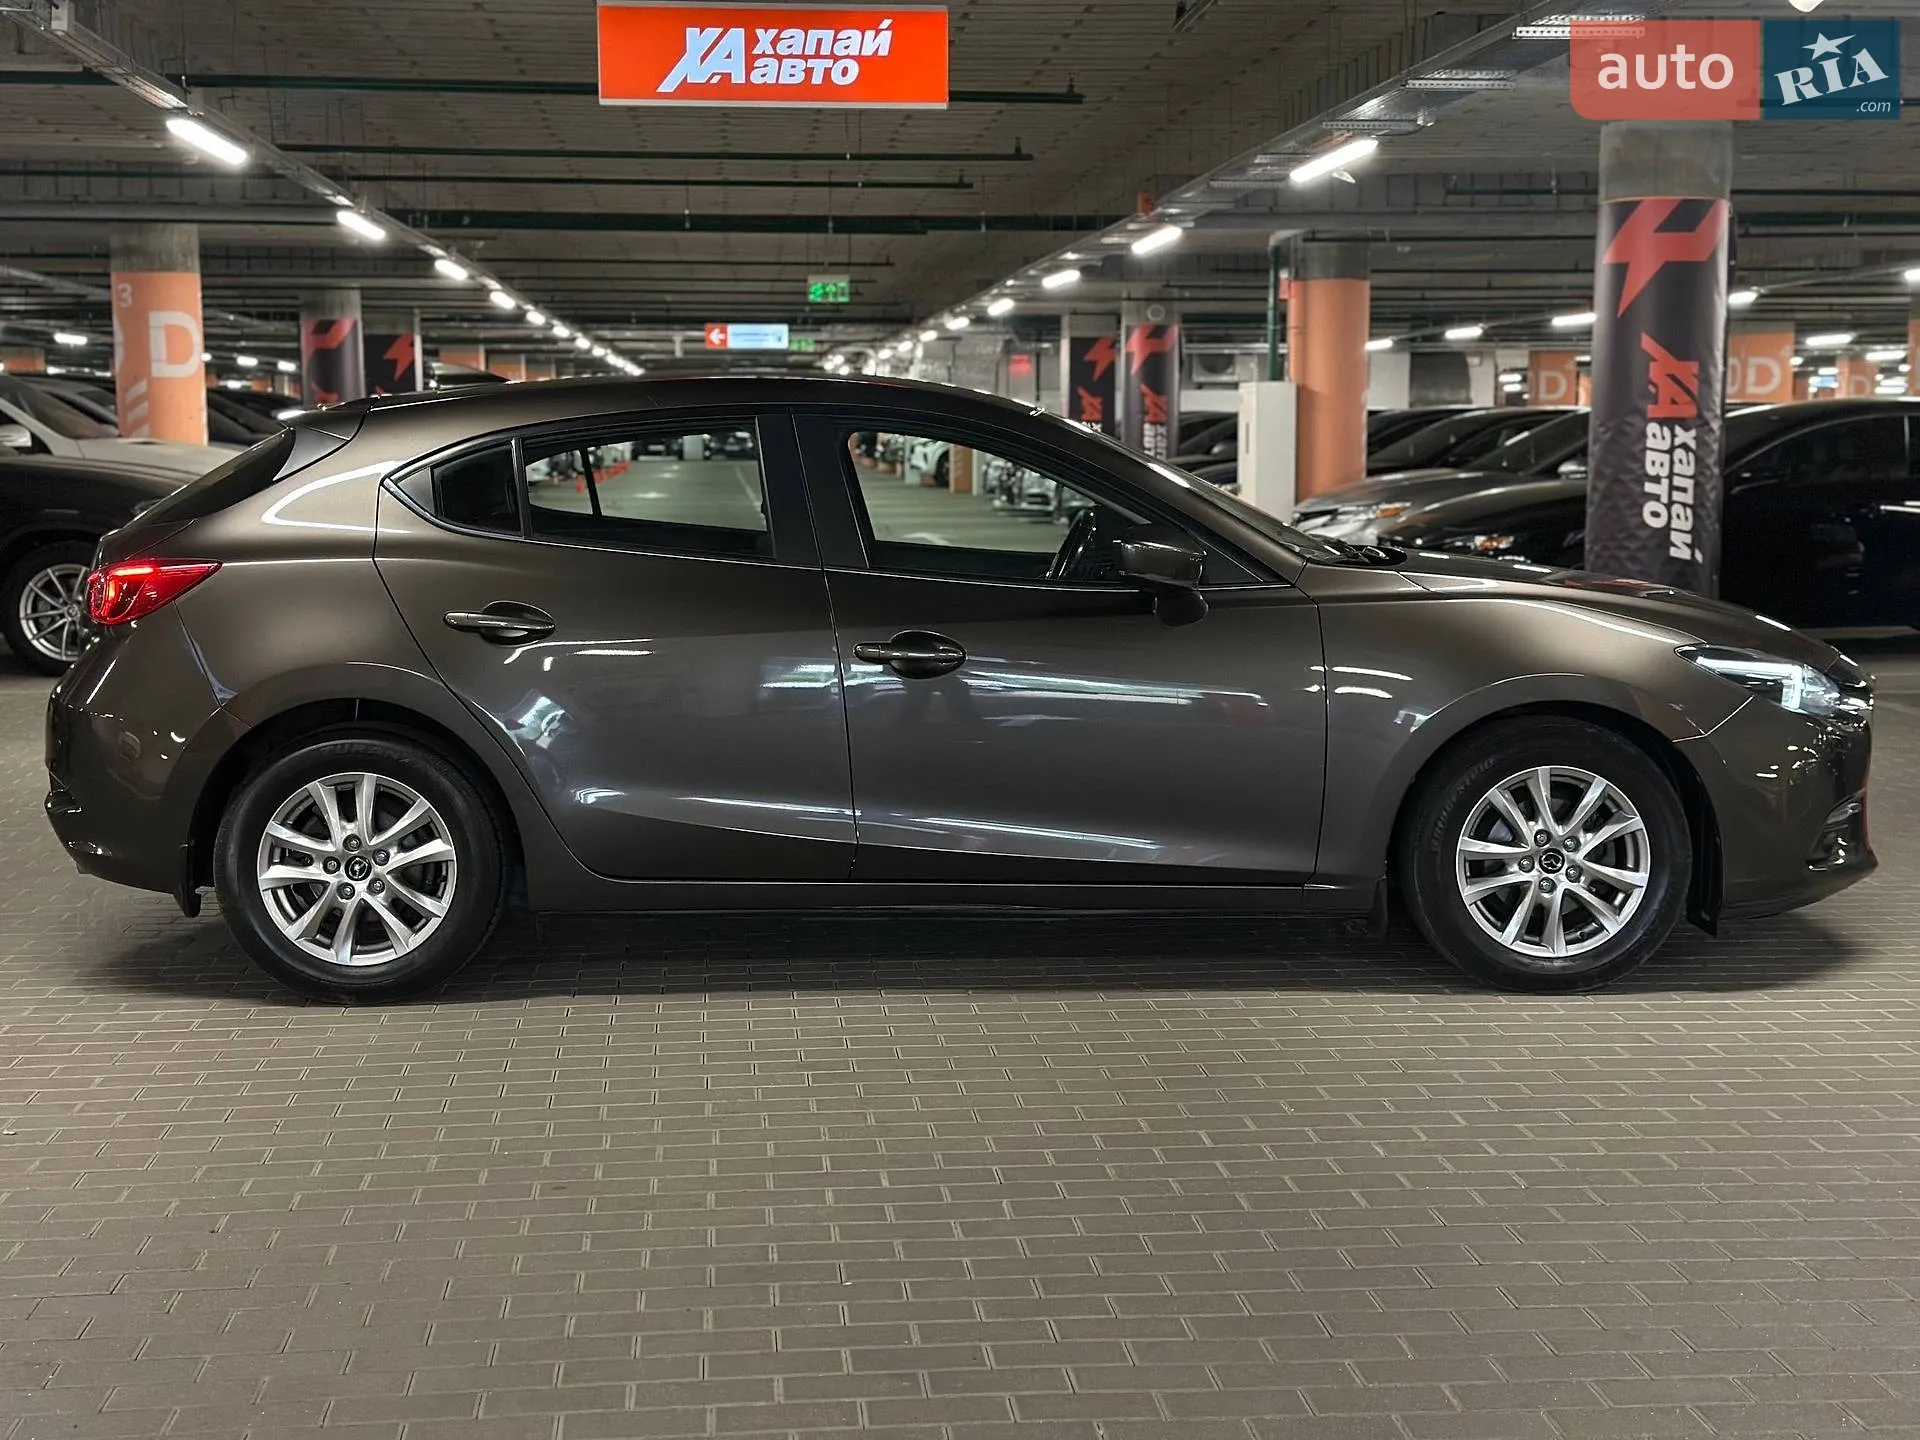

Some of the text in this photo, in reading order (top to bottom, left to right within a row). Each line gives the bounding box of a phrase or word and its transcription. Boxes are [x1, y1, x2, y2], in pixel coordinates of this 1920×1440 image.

[752, 18, 893, 56] хапай
[749, 57, 860, 86] авто
[148, 310, 201, 378] D
[1538, 371, 1568, 400] D
[1745, 355, 1782, 395] D
[1641, 421, 1672, 529] авто
[1668, 424, 1704, 565] хапай
